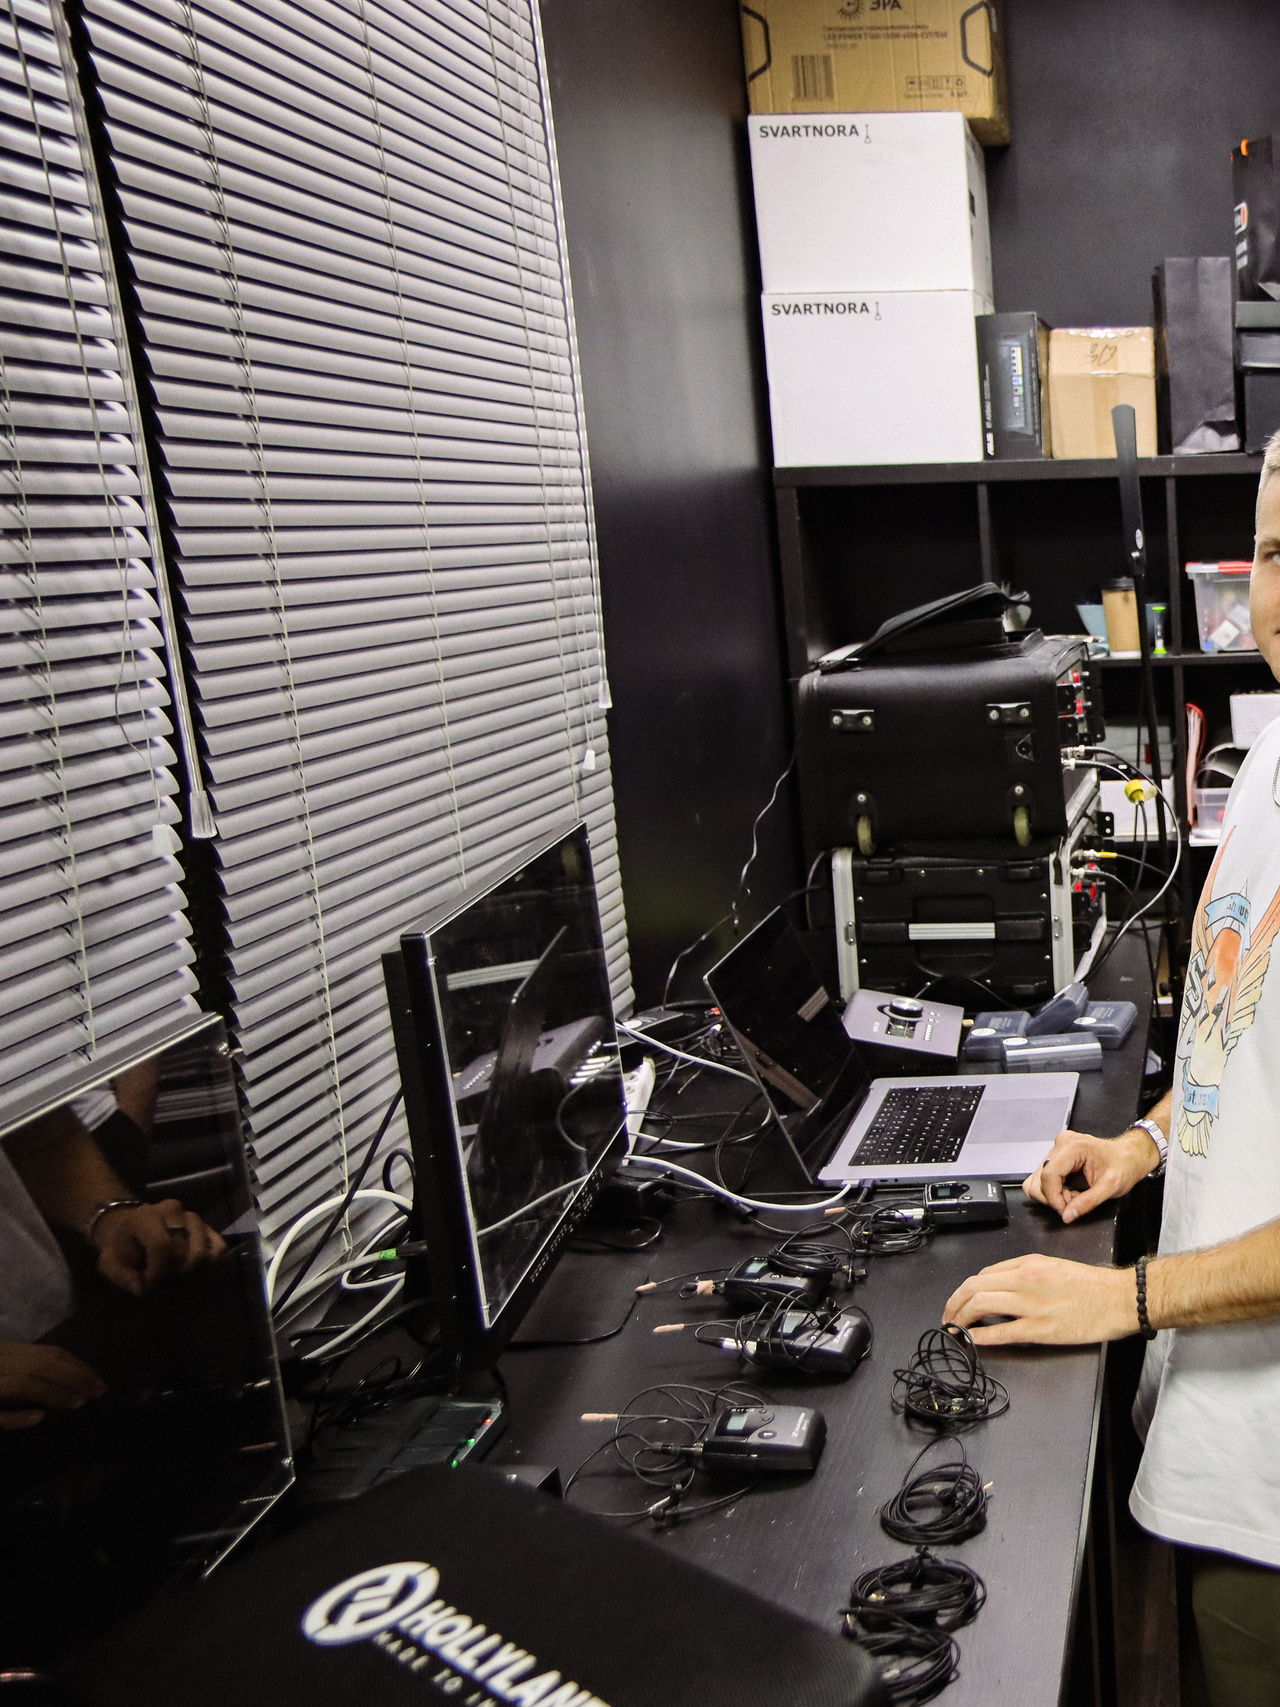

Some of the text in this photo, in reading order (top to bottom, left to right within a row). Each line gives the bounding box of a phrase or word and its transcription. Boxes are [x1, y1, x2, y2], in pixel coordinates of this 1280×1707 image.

[759, 124, 859, 138] SVARTNORA
[772, 302, 869, 315] SVARTNORA
[373, 1629, 430, 1672] MADE
[431, 1668, 463, 1694] TO
[399, 1599, 612, 1707] HOLLYLAN
